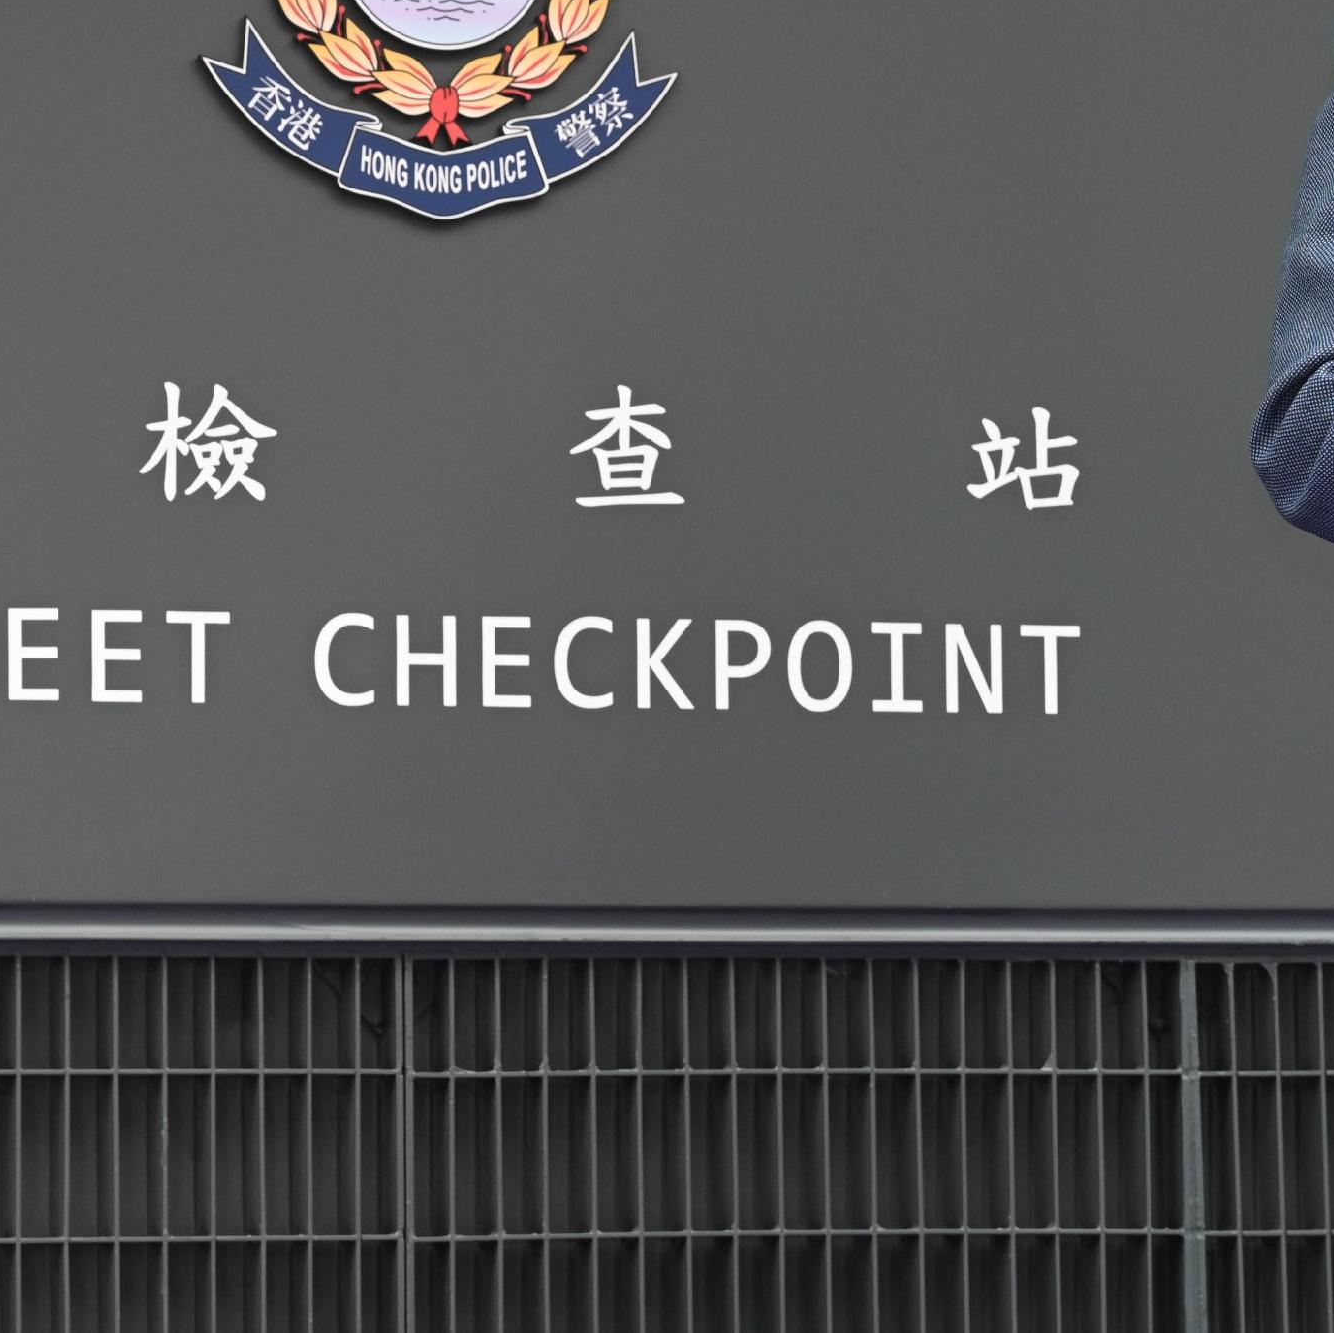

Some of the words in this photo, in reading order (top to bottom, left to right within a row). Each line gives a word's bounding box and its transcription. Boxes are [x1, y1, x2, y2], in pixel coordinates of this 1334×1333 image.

[247, 75, 324, 152] 香港
[554, 87, 634, 157] 警察
[360, 144, 408, 189] HONG
[413, 164, 462, 193] KONG
[466, 150, 527, 192] POLICE
[314, 612, 1081, 715] CHECKPOINT
